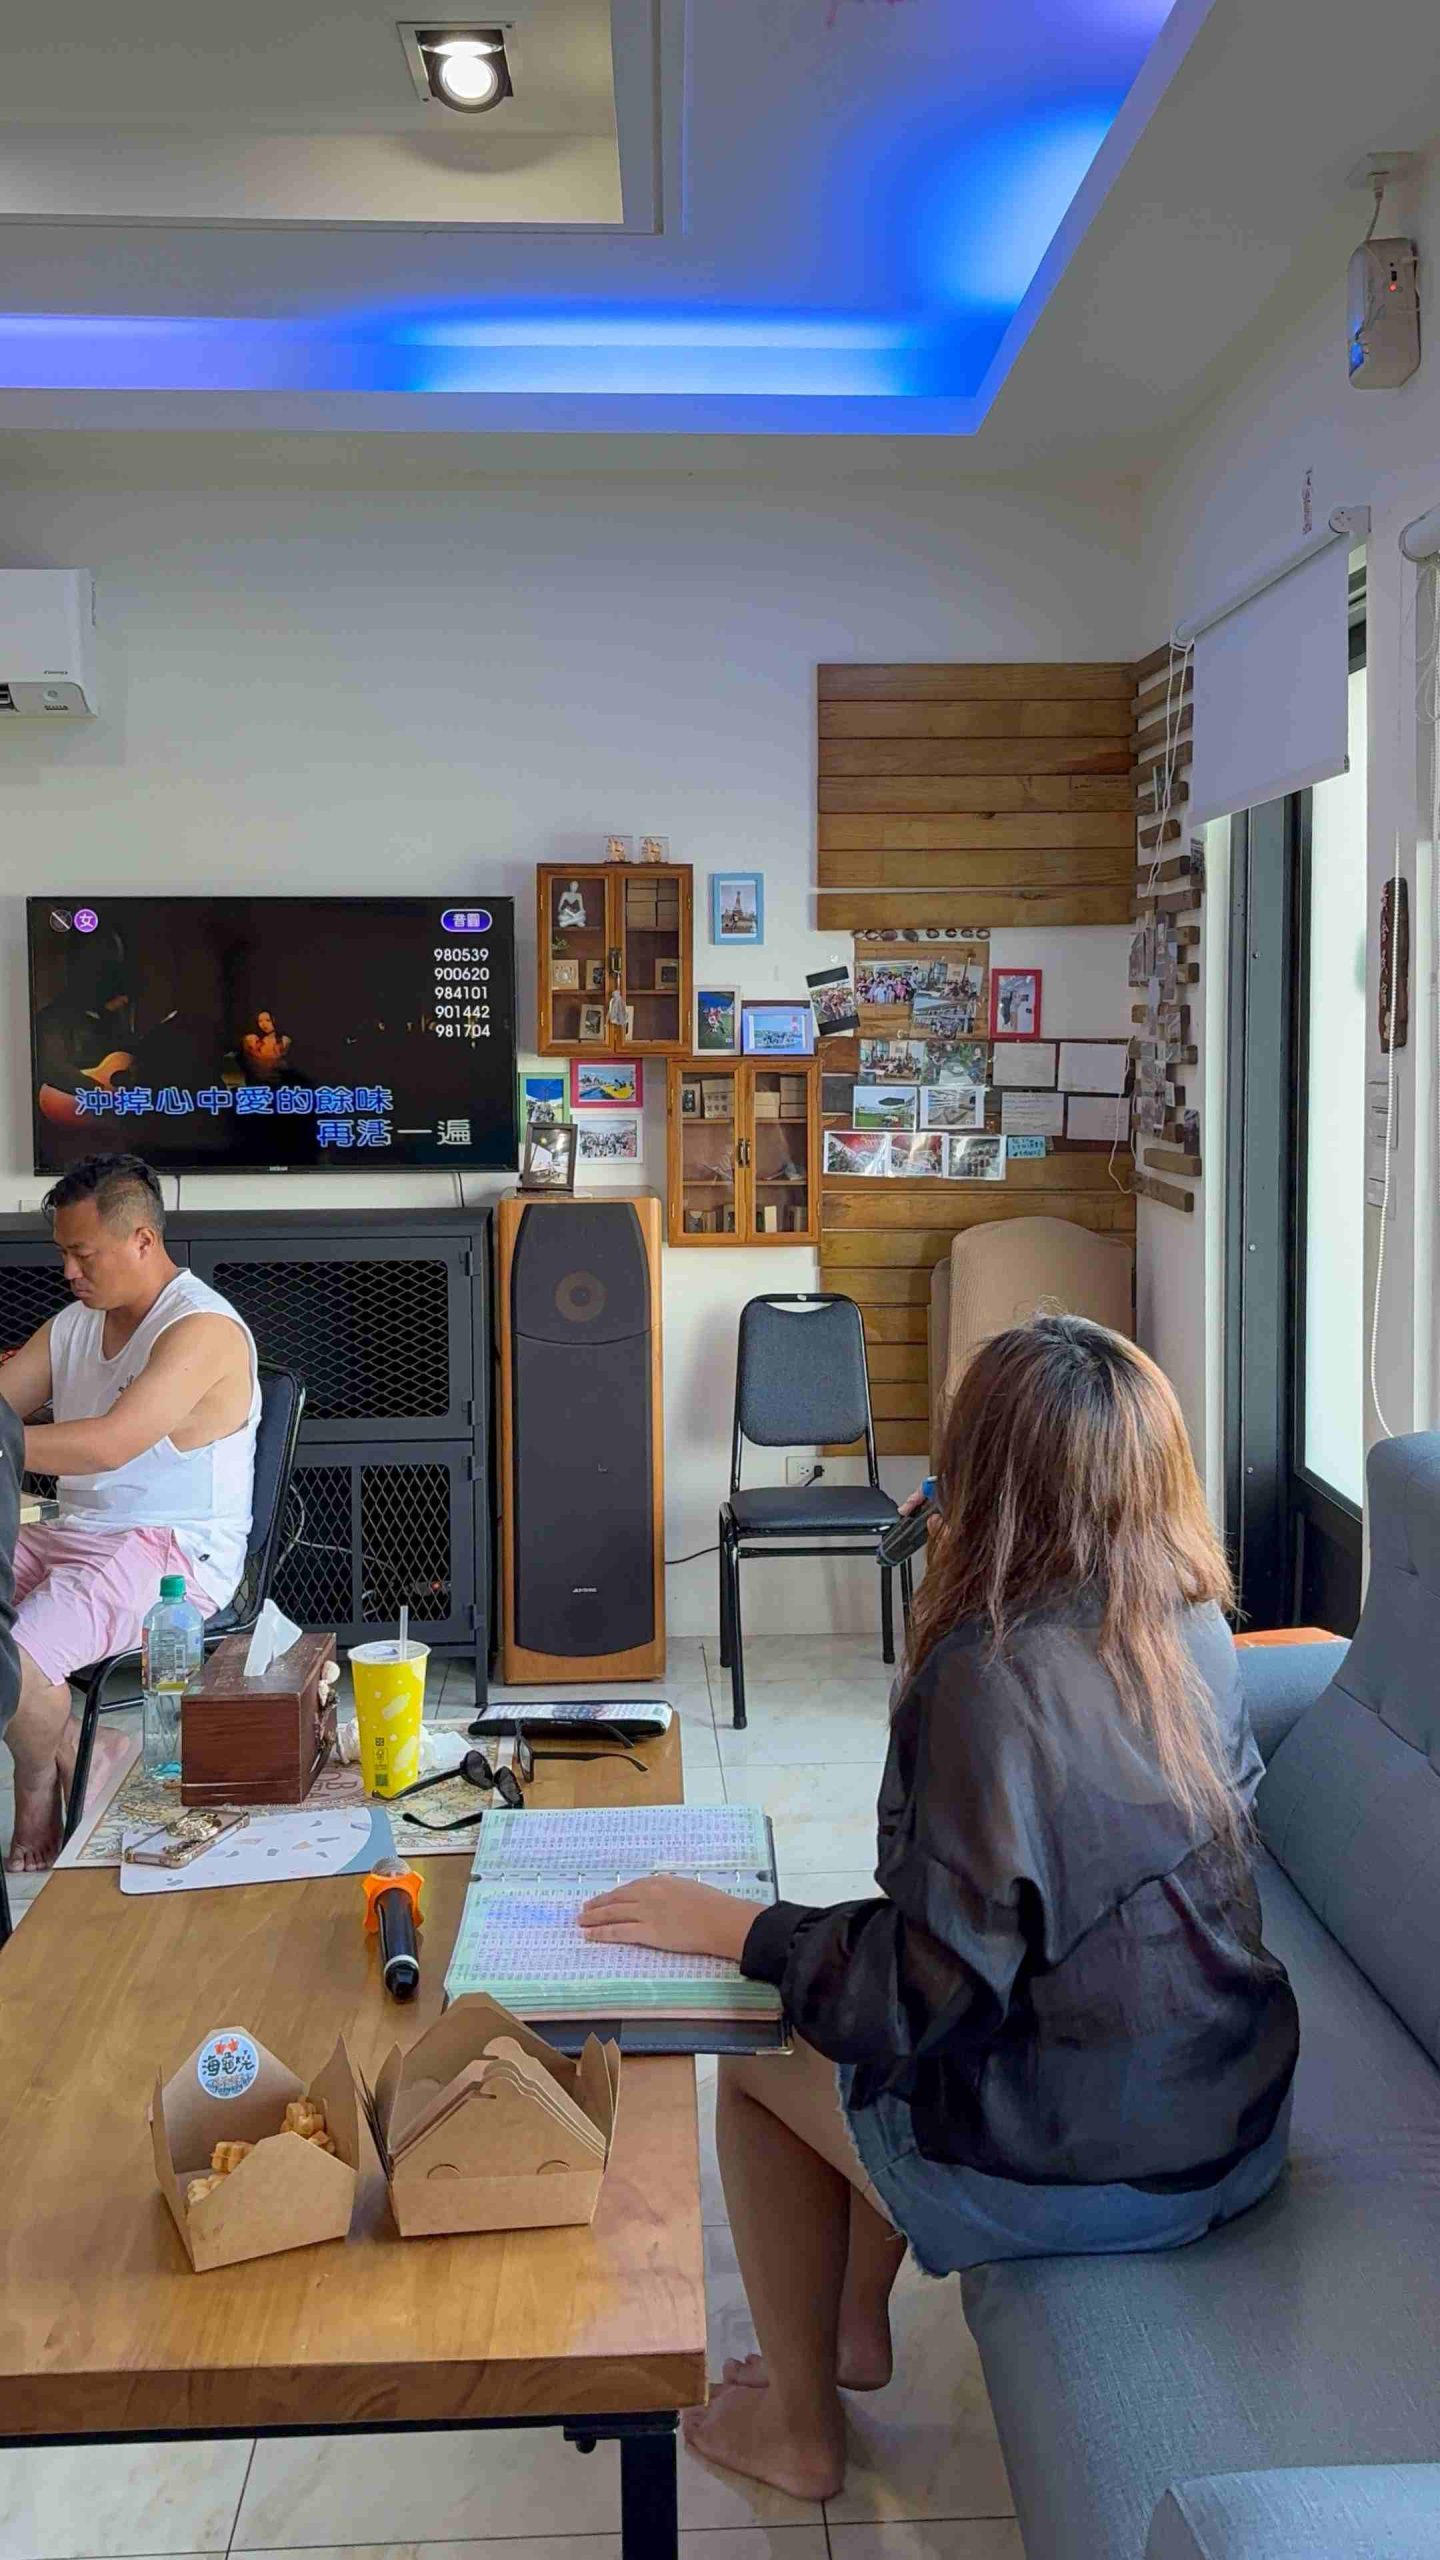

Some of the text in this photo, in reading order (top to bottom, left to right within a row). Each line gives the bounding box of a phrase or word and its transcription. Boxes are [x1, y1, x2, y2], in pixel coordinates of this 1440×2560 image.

[79, 913, 94, 928] 女
[433, 948, 489, 961] 980539
[434, 967, 490, 981] 900620
[434, 986, 488, 1000] 984101
[435, 1005, 490, 1019] 901442
[435, 1024, 491, 1038] 981704
[75, 1085, 394, 1116] 沖掉心中愛的餘味
[316, 1118, 473, 1147] 再活一遍
